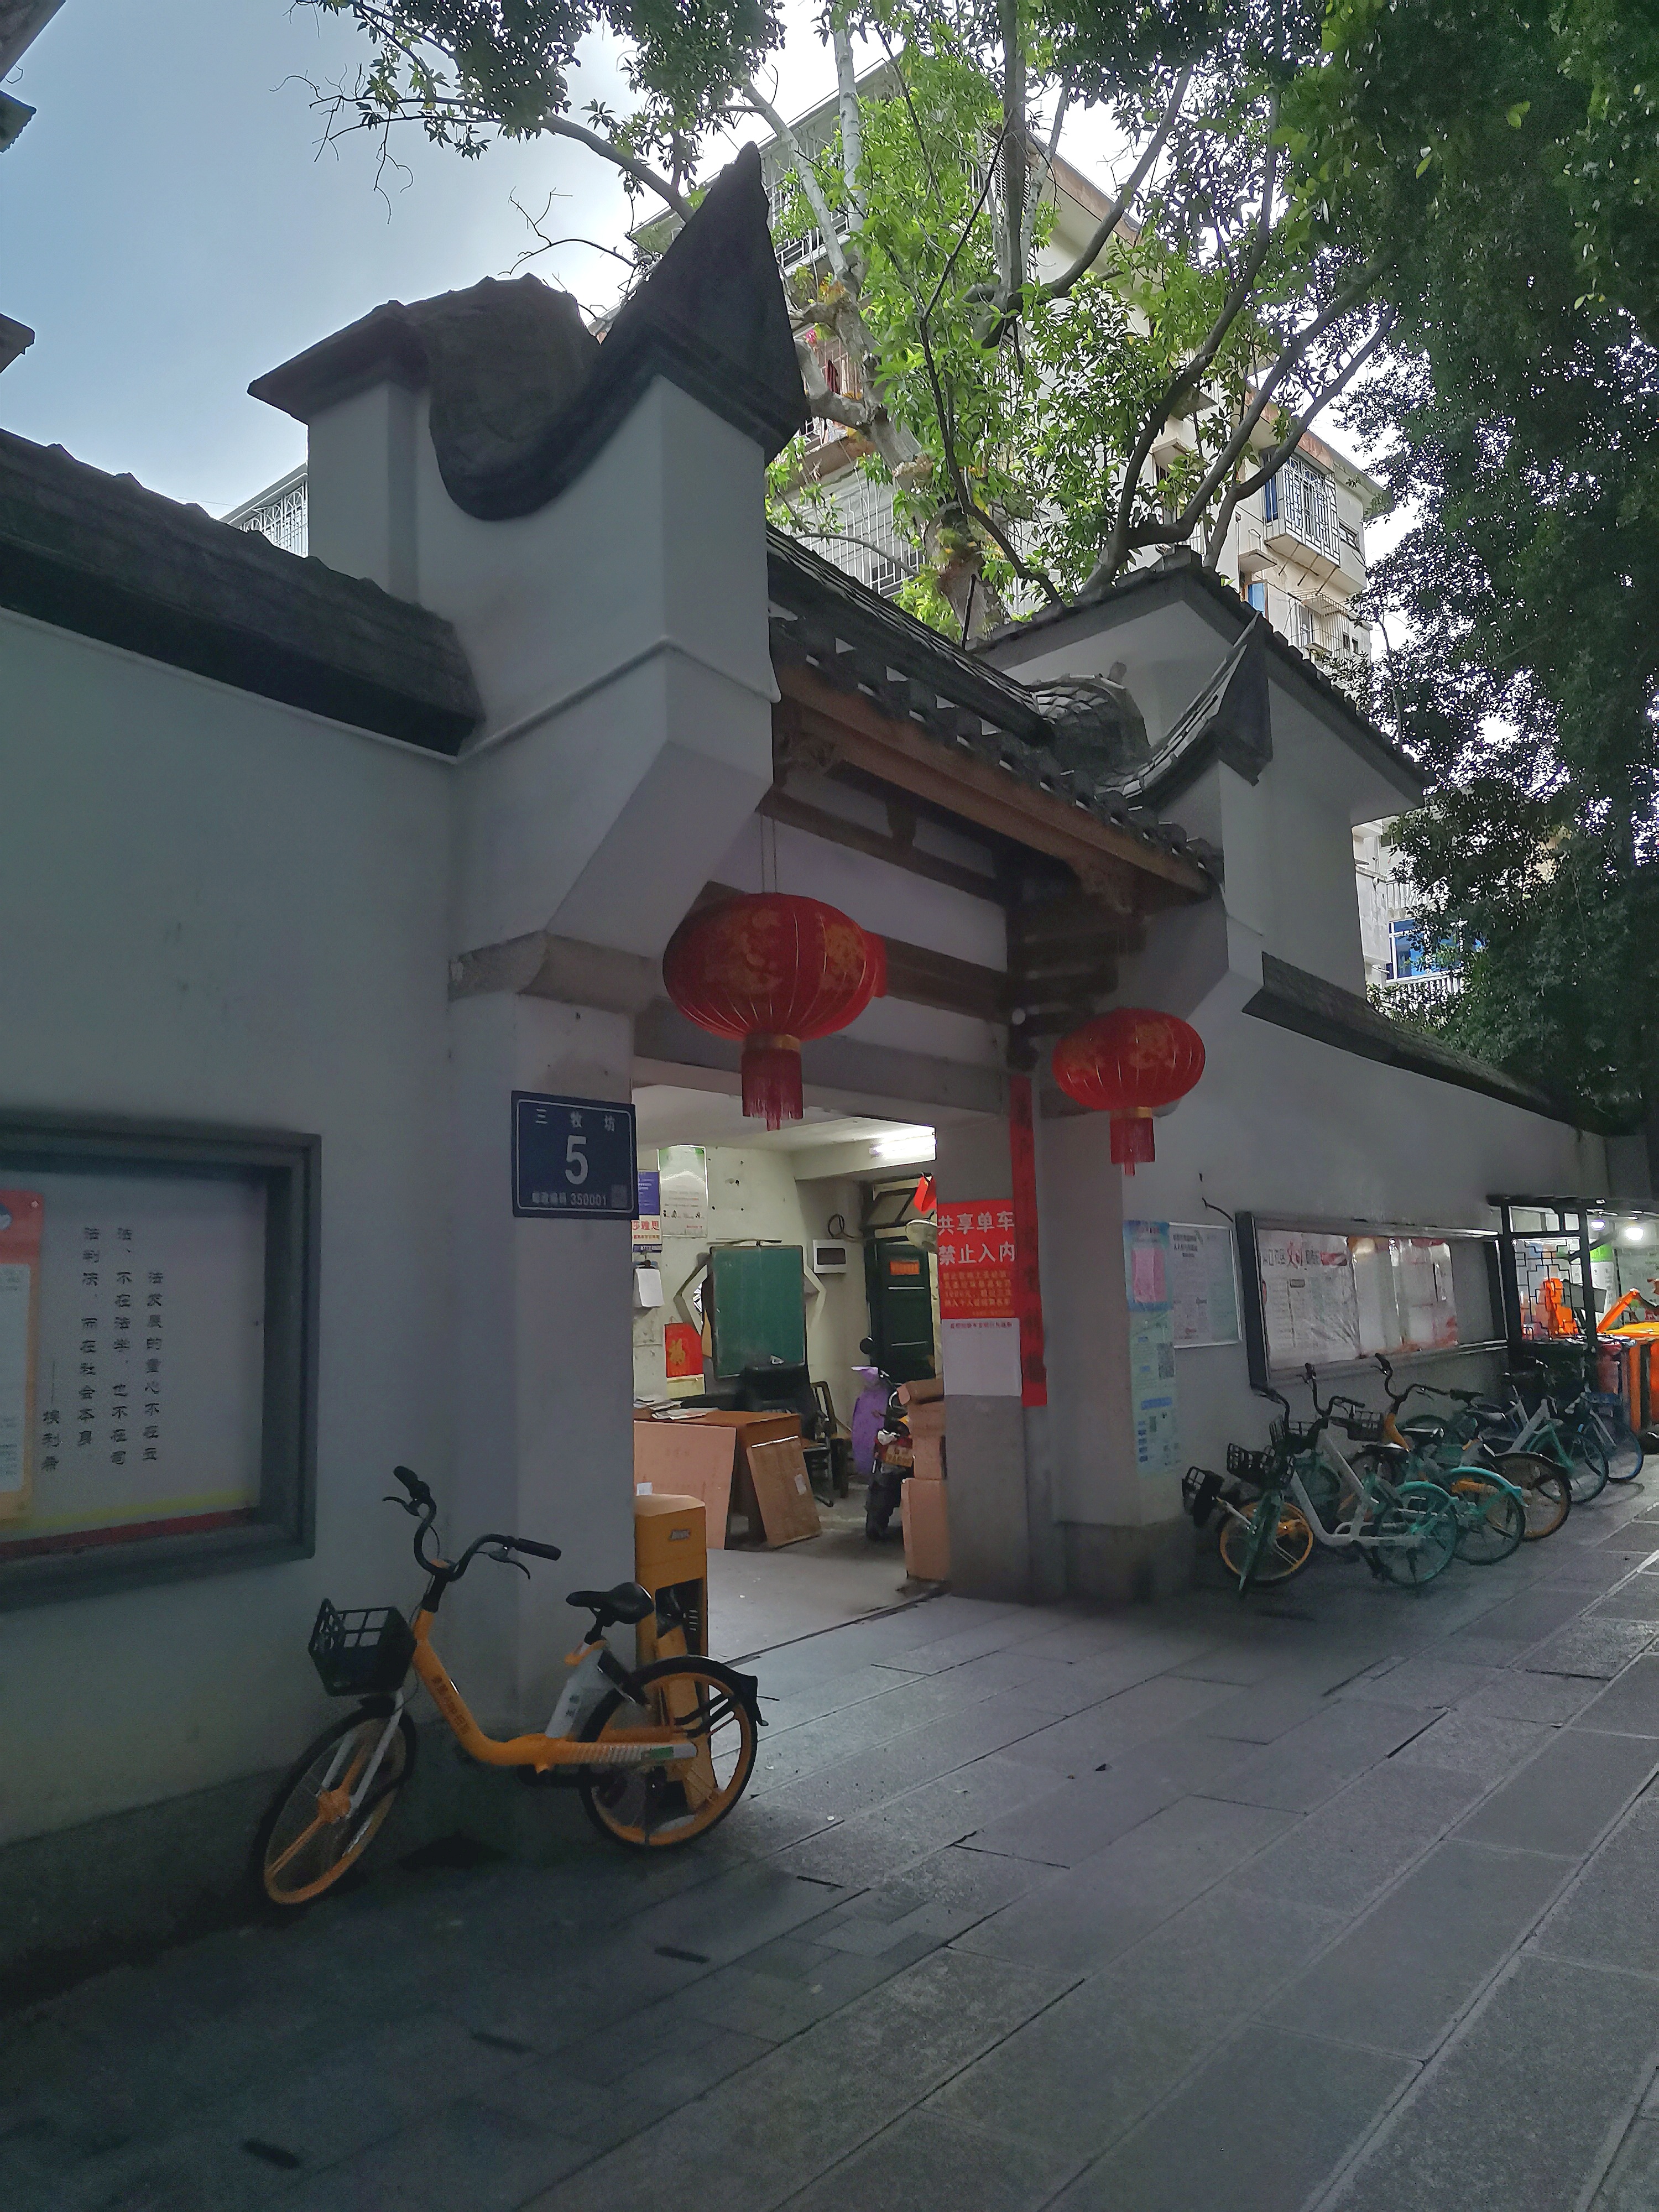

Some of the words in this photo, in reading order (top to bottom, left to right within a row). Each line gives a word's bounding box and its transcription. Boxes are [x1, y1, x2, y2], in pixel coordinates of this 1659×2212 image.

[565, 1135, 588, 1185] 5
[570, 1192, 607, 1206] 350001
[937, 1210, 1015, 1236] 共享单车
[938, 1240, 1016, 1265] 禁止入内
